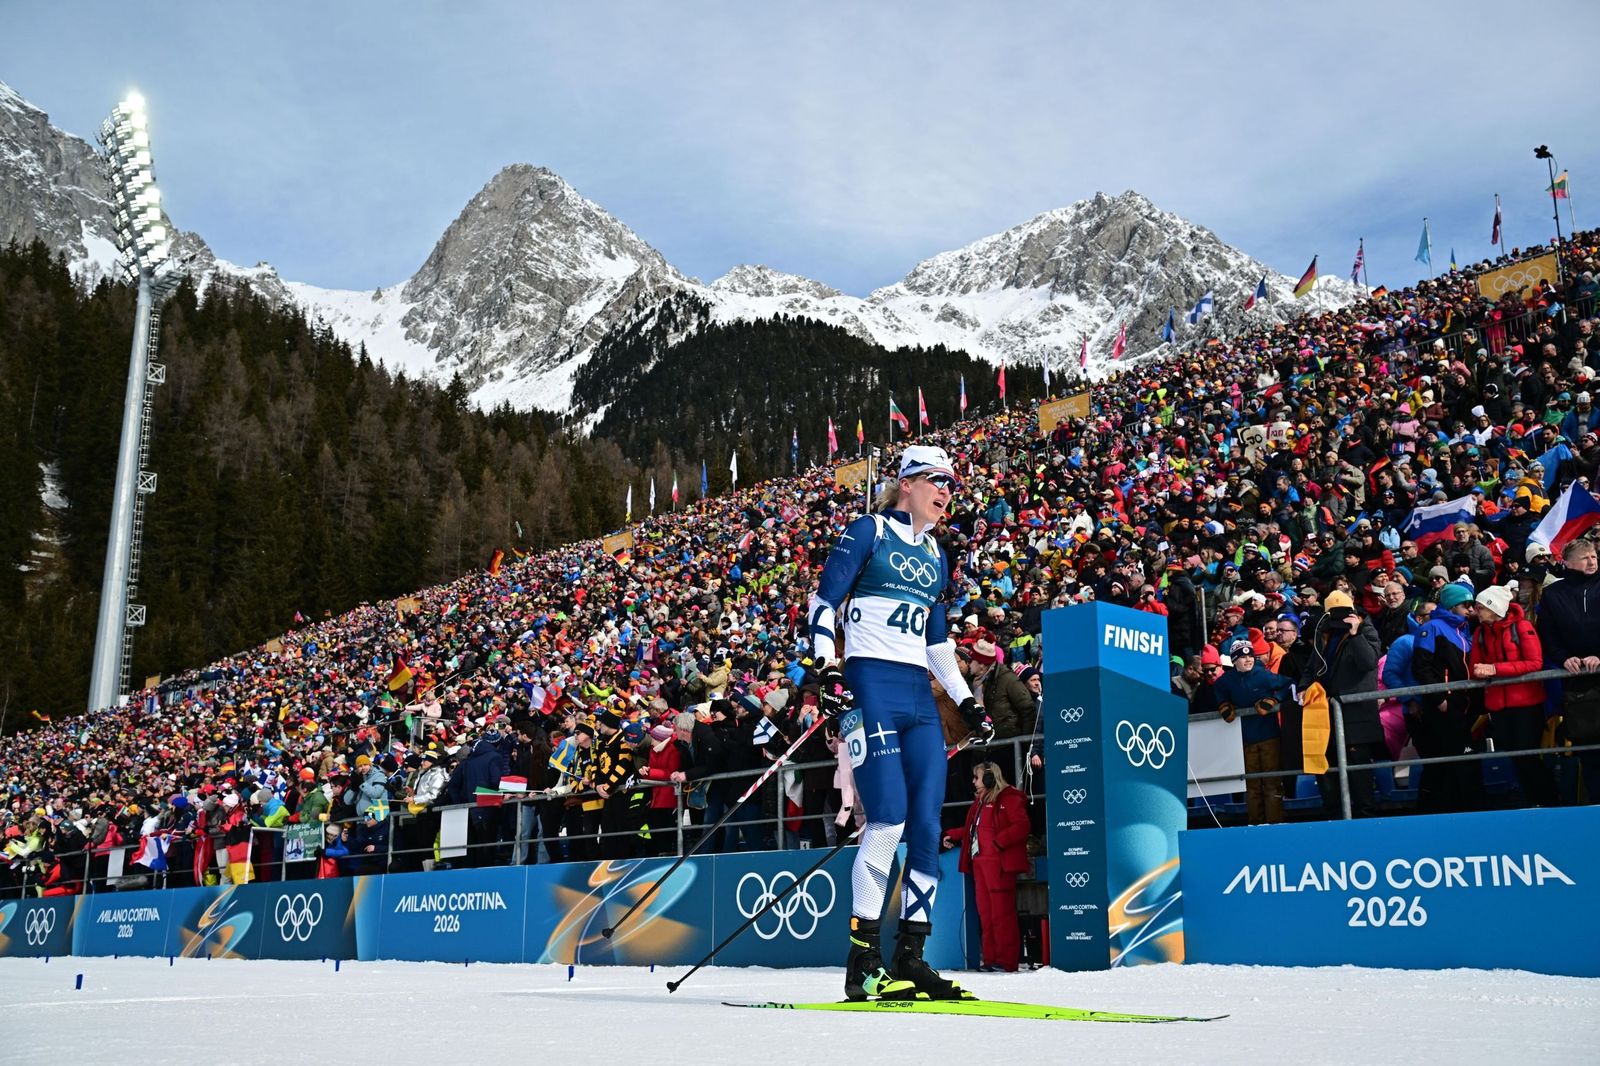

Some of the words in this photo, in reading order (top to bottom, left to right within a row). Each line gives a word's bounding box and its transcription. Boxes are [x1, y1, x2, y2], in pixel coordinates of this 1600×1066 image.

[881, 582, 909, 592] MILANO
[909, 587, 929, 599] CORTINA
[886, 602, 925, 637] 40
[1103, 623, 1164, 657] FINISH
[1222, 859, 1377, 895] MILANO
[1385, 852, 1577, 889] CORTINA
[394, 893, 447, 913] MILANO
[448, 891, 508, 911] CORTINA
[1346, 896, 1428, 927] 2026
[96, 908, 128, 924] MILANO
[128, 907, 161, 922] CORTINA
[433, 914, 461, 933] 2026
[117, 924, 134, 938] 2026
